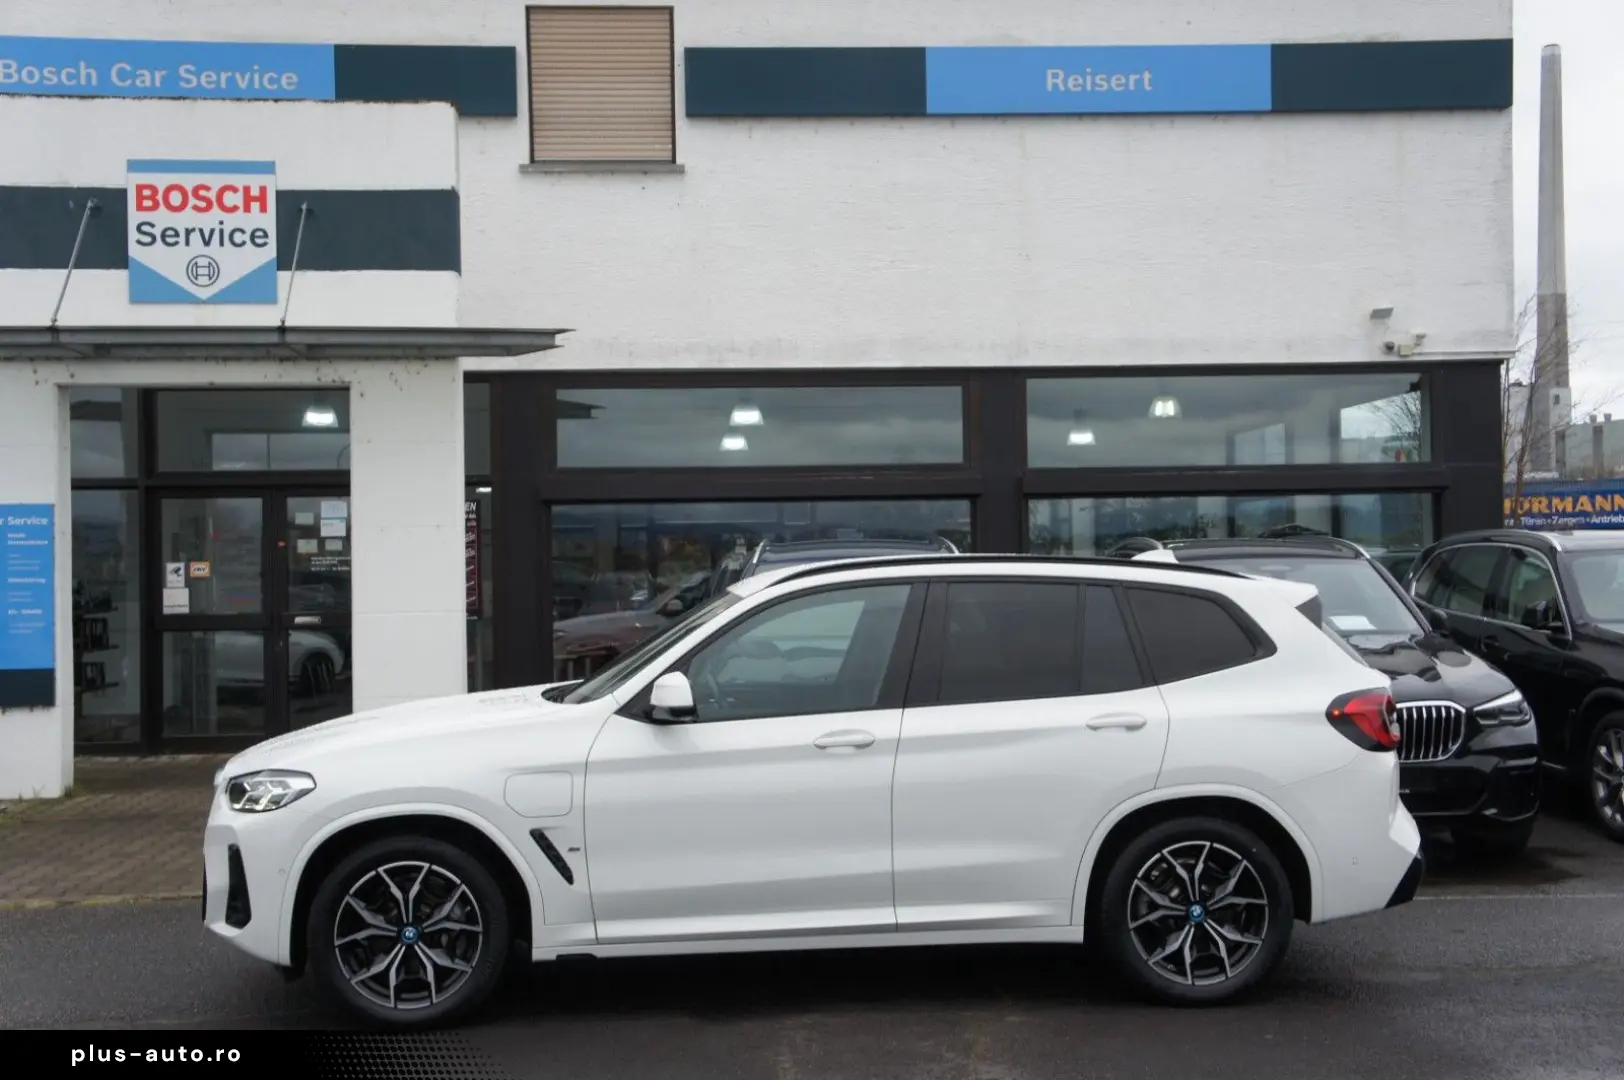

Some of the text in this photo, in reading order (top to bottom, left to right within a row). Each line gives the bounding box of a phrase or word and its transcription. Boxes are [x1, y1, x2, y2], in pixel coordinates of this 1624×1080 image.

[0, 59, 298, 90] Bosch Car Service
[1045, 67, 1153, 93] Reisert
[135, 183, 268, 213] BOSCH
[135, 219, 270, 248] Service
[8, 516, 49, 526] Service
